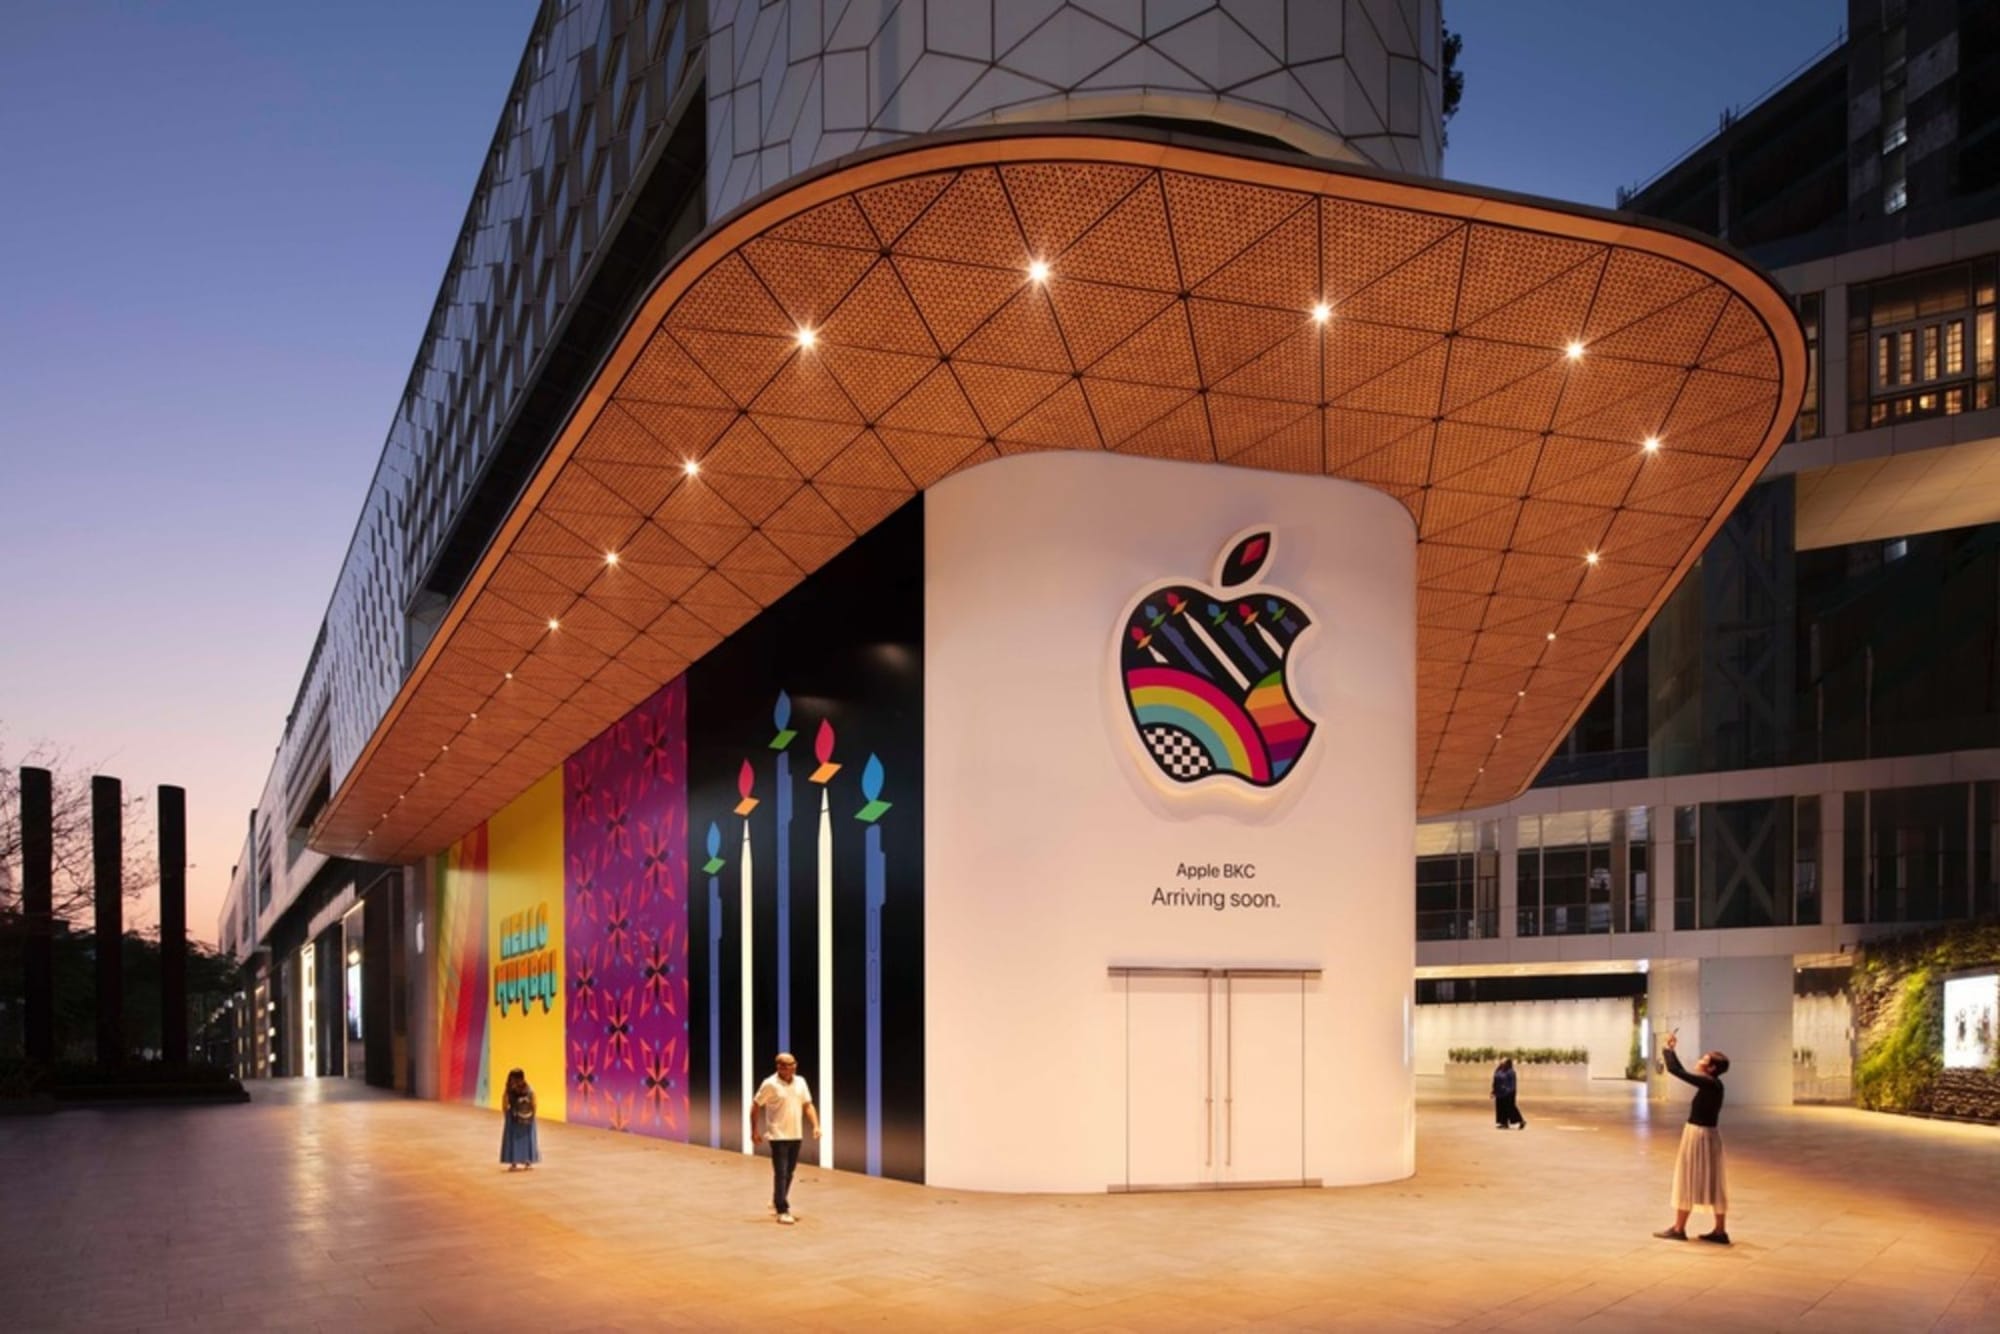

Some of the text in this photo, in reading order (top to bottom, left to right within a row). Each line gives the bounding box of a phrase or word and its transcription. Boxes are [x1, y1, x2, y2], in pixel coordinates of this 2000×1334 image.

[1175, 862, 1256, 880] Apple BKC
[1151, 887, 1281, 911] Arriving soon.
